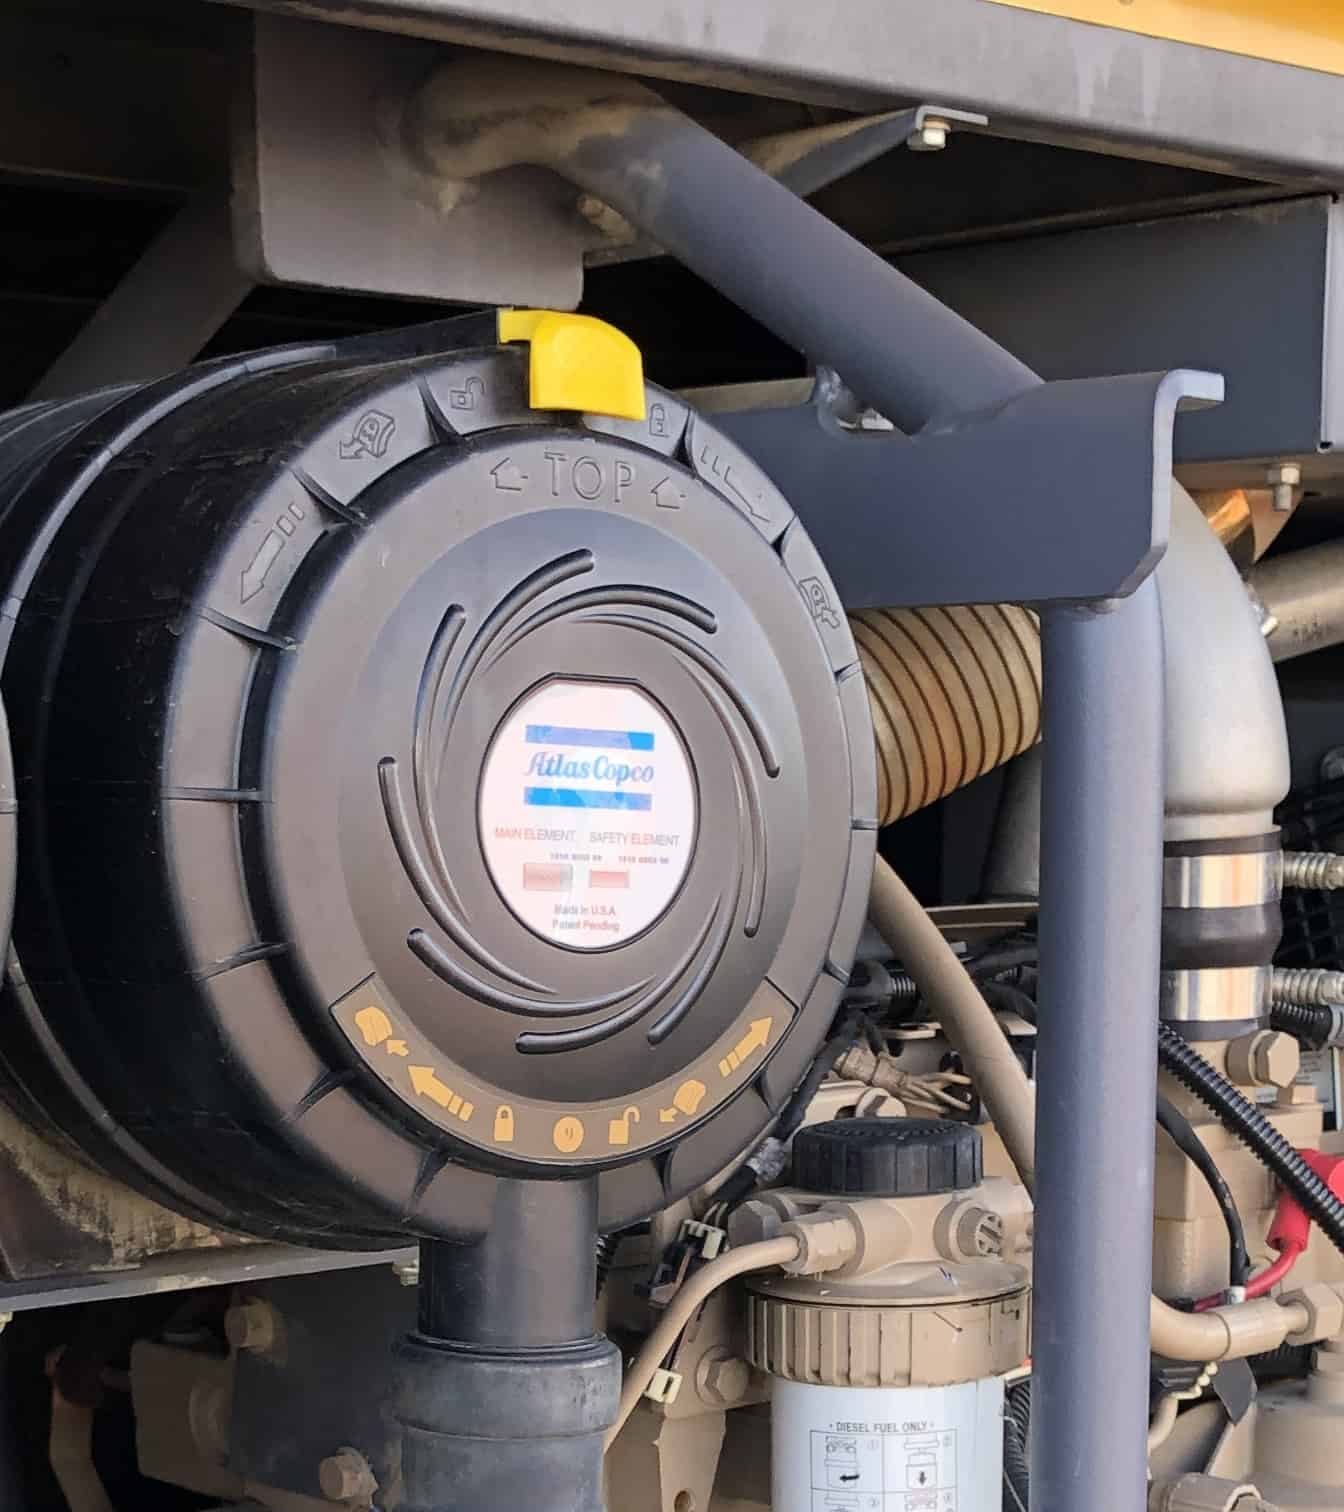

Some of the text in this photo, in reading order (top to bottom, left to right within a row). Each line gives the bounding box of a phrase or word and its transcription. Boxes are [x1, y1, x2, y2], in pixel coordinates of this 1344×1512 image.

[543, 449, 637, 503] TOP
[525, 750, 655, 786] Atlas Copco
[495, 826, 576, 842] MAIN ELEMENT
[589, 831, 681, 848] SAFETY ELEMENT
[836, 1421, 928, 1433] DIESEL FUEL ONLY
